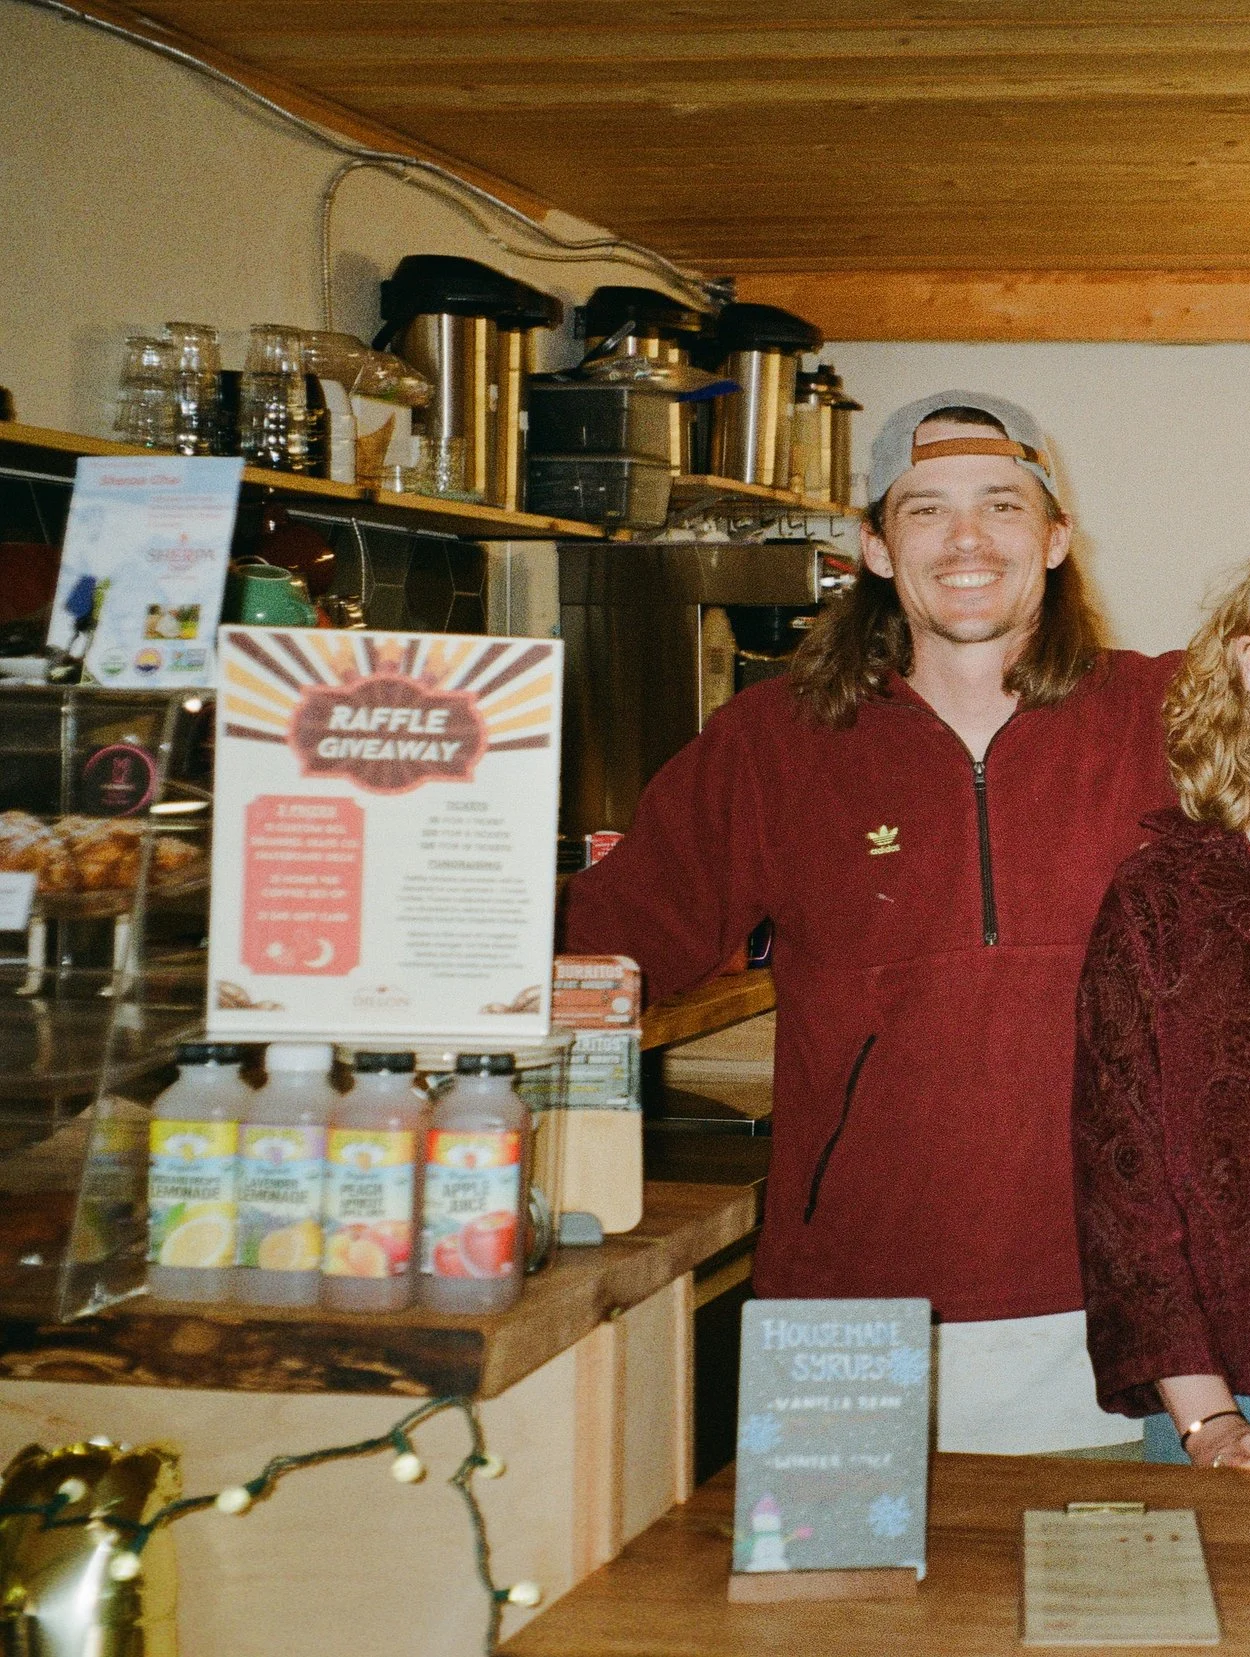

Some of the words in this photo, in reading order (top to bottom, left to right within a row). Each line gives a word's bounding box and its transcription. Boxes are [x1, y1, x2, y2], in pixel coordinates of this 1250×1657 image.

[328, 706, 449, 733] RAFFLE
[317, 737, 461, 761] GIVEAWAY
[870, 844, 901, 855] adidas
[150, 1185, 221, 1198] LEMONADE
[761, 1318, 901, 1349] HOUSEMADE
[791, 1353, 888, 1382] SYRUPS
